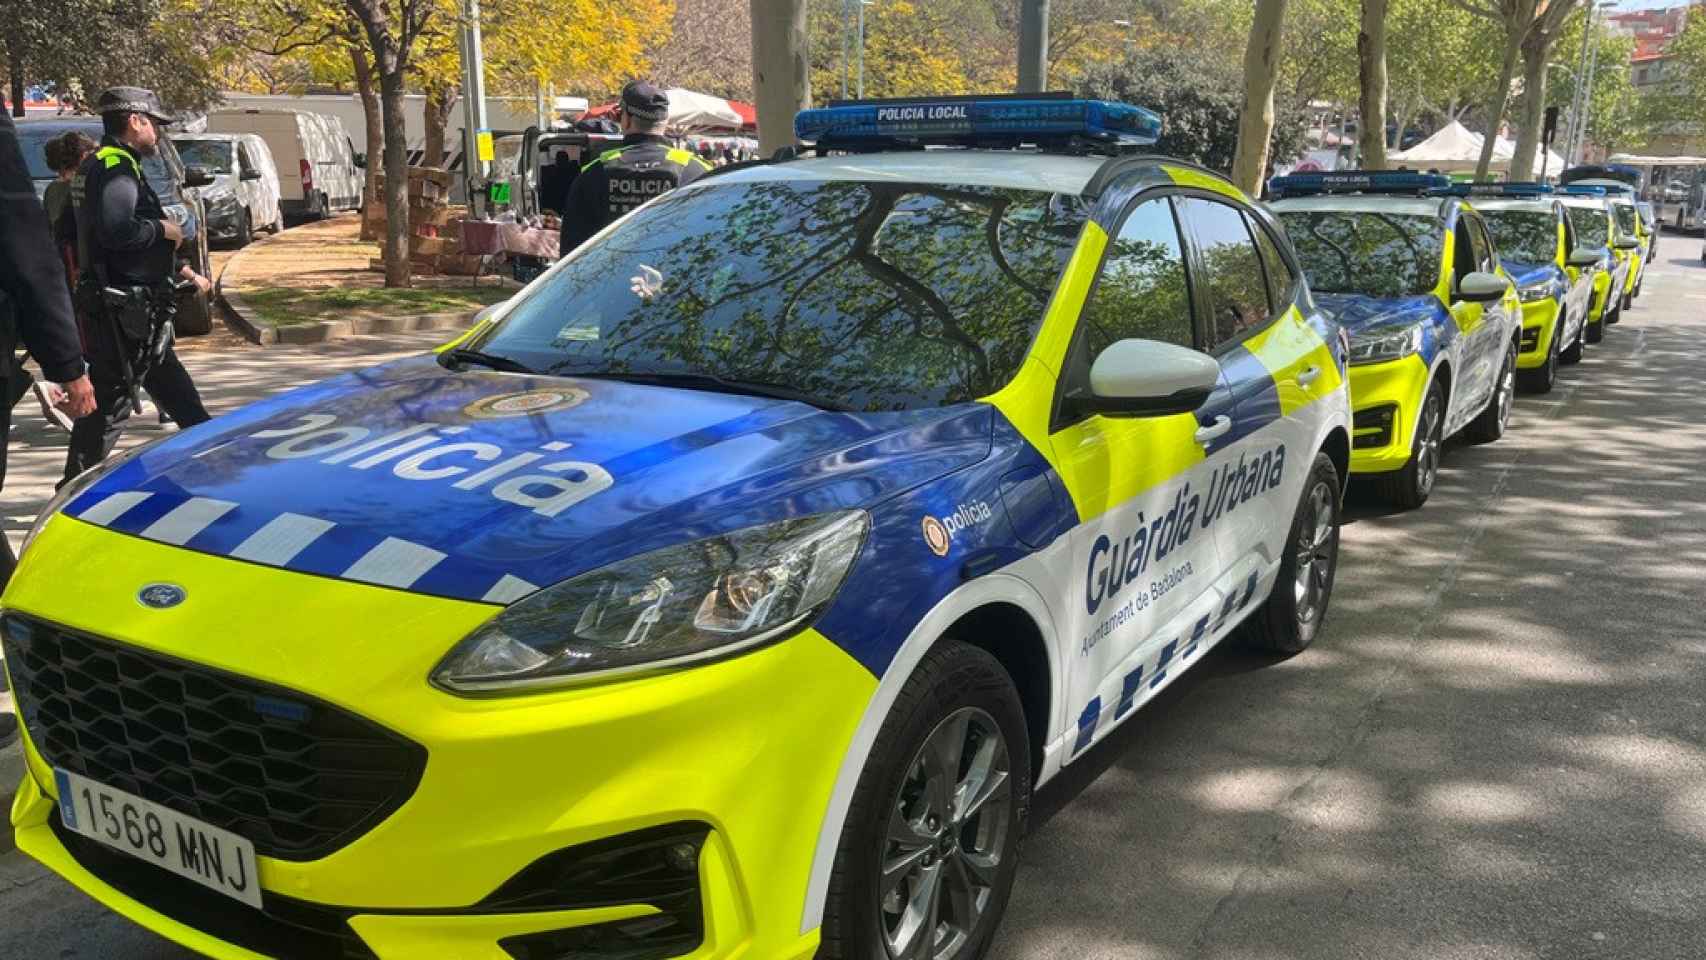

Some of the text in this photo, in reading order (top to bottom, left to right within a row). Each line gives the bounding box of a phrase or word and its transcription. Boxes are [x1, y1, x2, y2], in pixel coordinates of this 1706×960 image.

[878, 105, 967, 120] POLICIA LOCAL
[609, 179, 674, 194] POLICIA
[942, 499, 993, 541] policia
[1086, 444, 1286, 616] Guàrdia Urbana
[1080, 560, 1194, 658] Auntament de Badalona
[82, 787, 247, 892] 1568 MNJ
